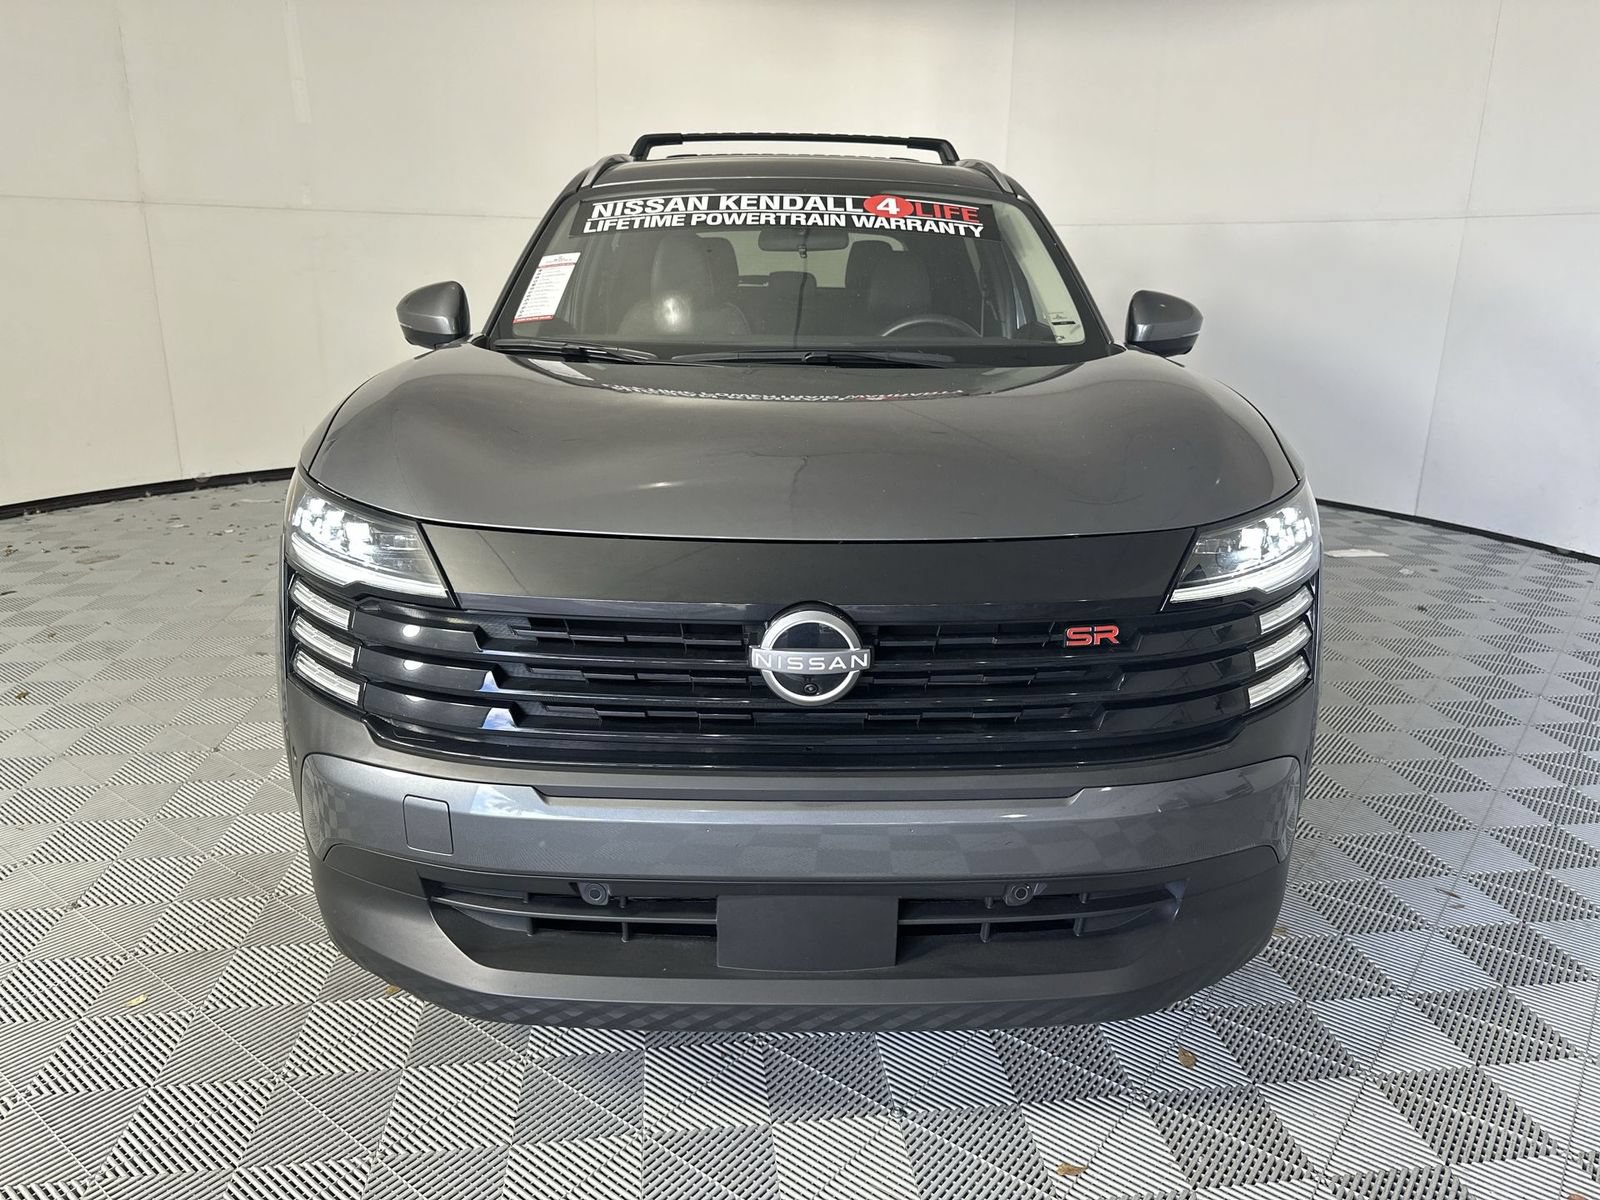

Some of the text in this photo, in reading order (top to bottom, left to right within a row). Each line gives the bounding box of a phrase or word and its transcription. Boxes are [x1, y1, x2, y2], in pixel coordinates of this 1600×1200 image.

[591, 195, 981, 223] NISSAN KENDALL 4 LIFE
[583, 212, 984, 238] LIFETIME POWERTRAIN WARRANTY
[1066, 624, 1120, 646] SR
[755, 653, 868, 671] NISSAN
